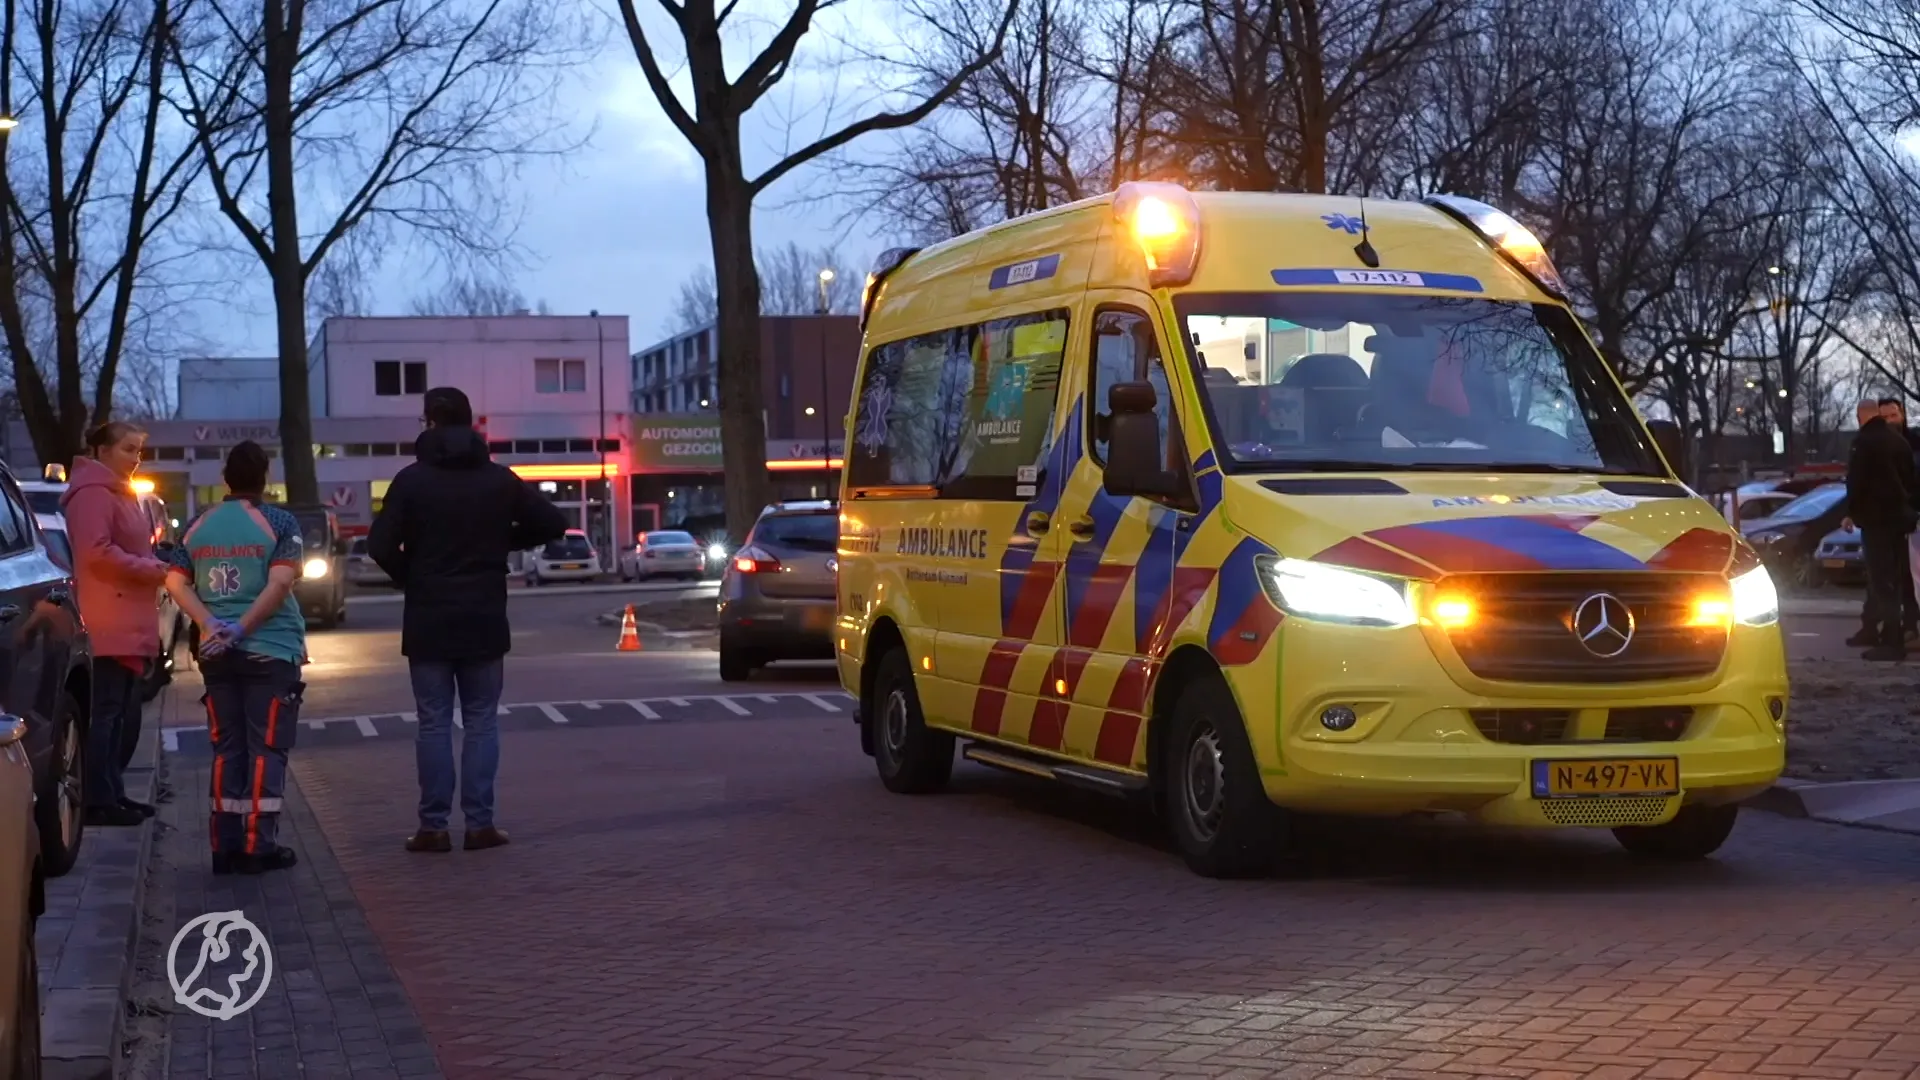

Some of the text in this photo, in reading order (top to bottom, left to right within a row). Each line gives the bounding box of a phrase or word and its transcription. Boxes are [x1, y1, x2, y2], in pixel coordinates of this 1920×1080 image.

[1350, 272, 1411, 284] 17-112
[977, 420, 1021, 436] AMBULANCE
[897, 527, 988, 558] AMBULANCE
[1536, 763, 1669, 790] NL N-497-VK
